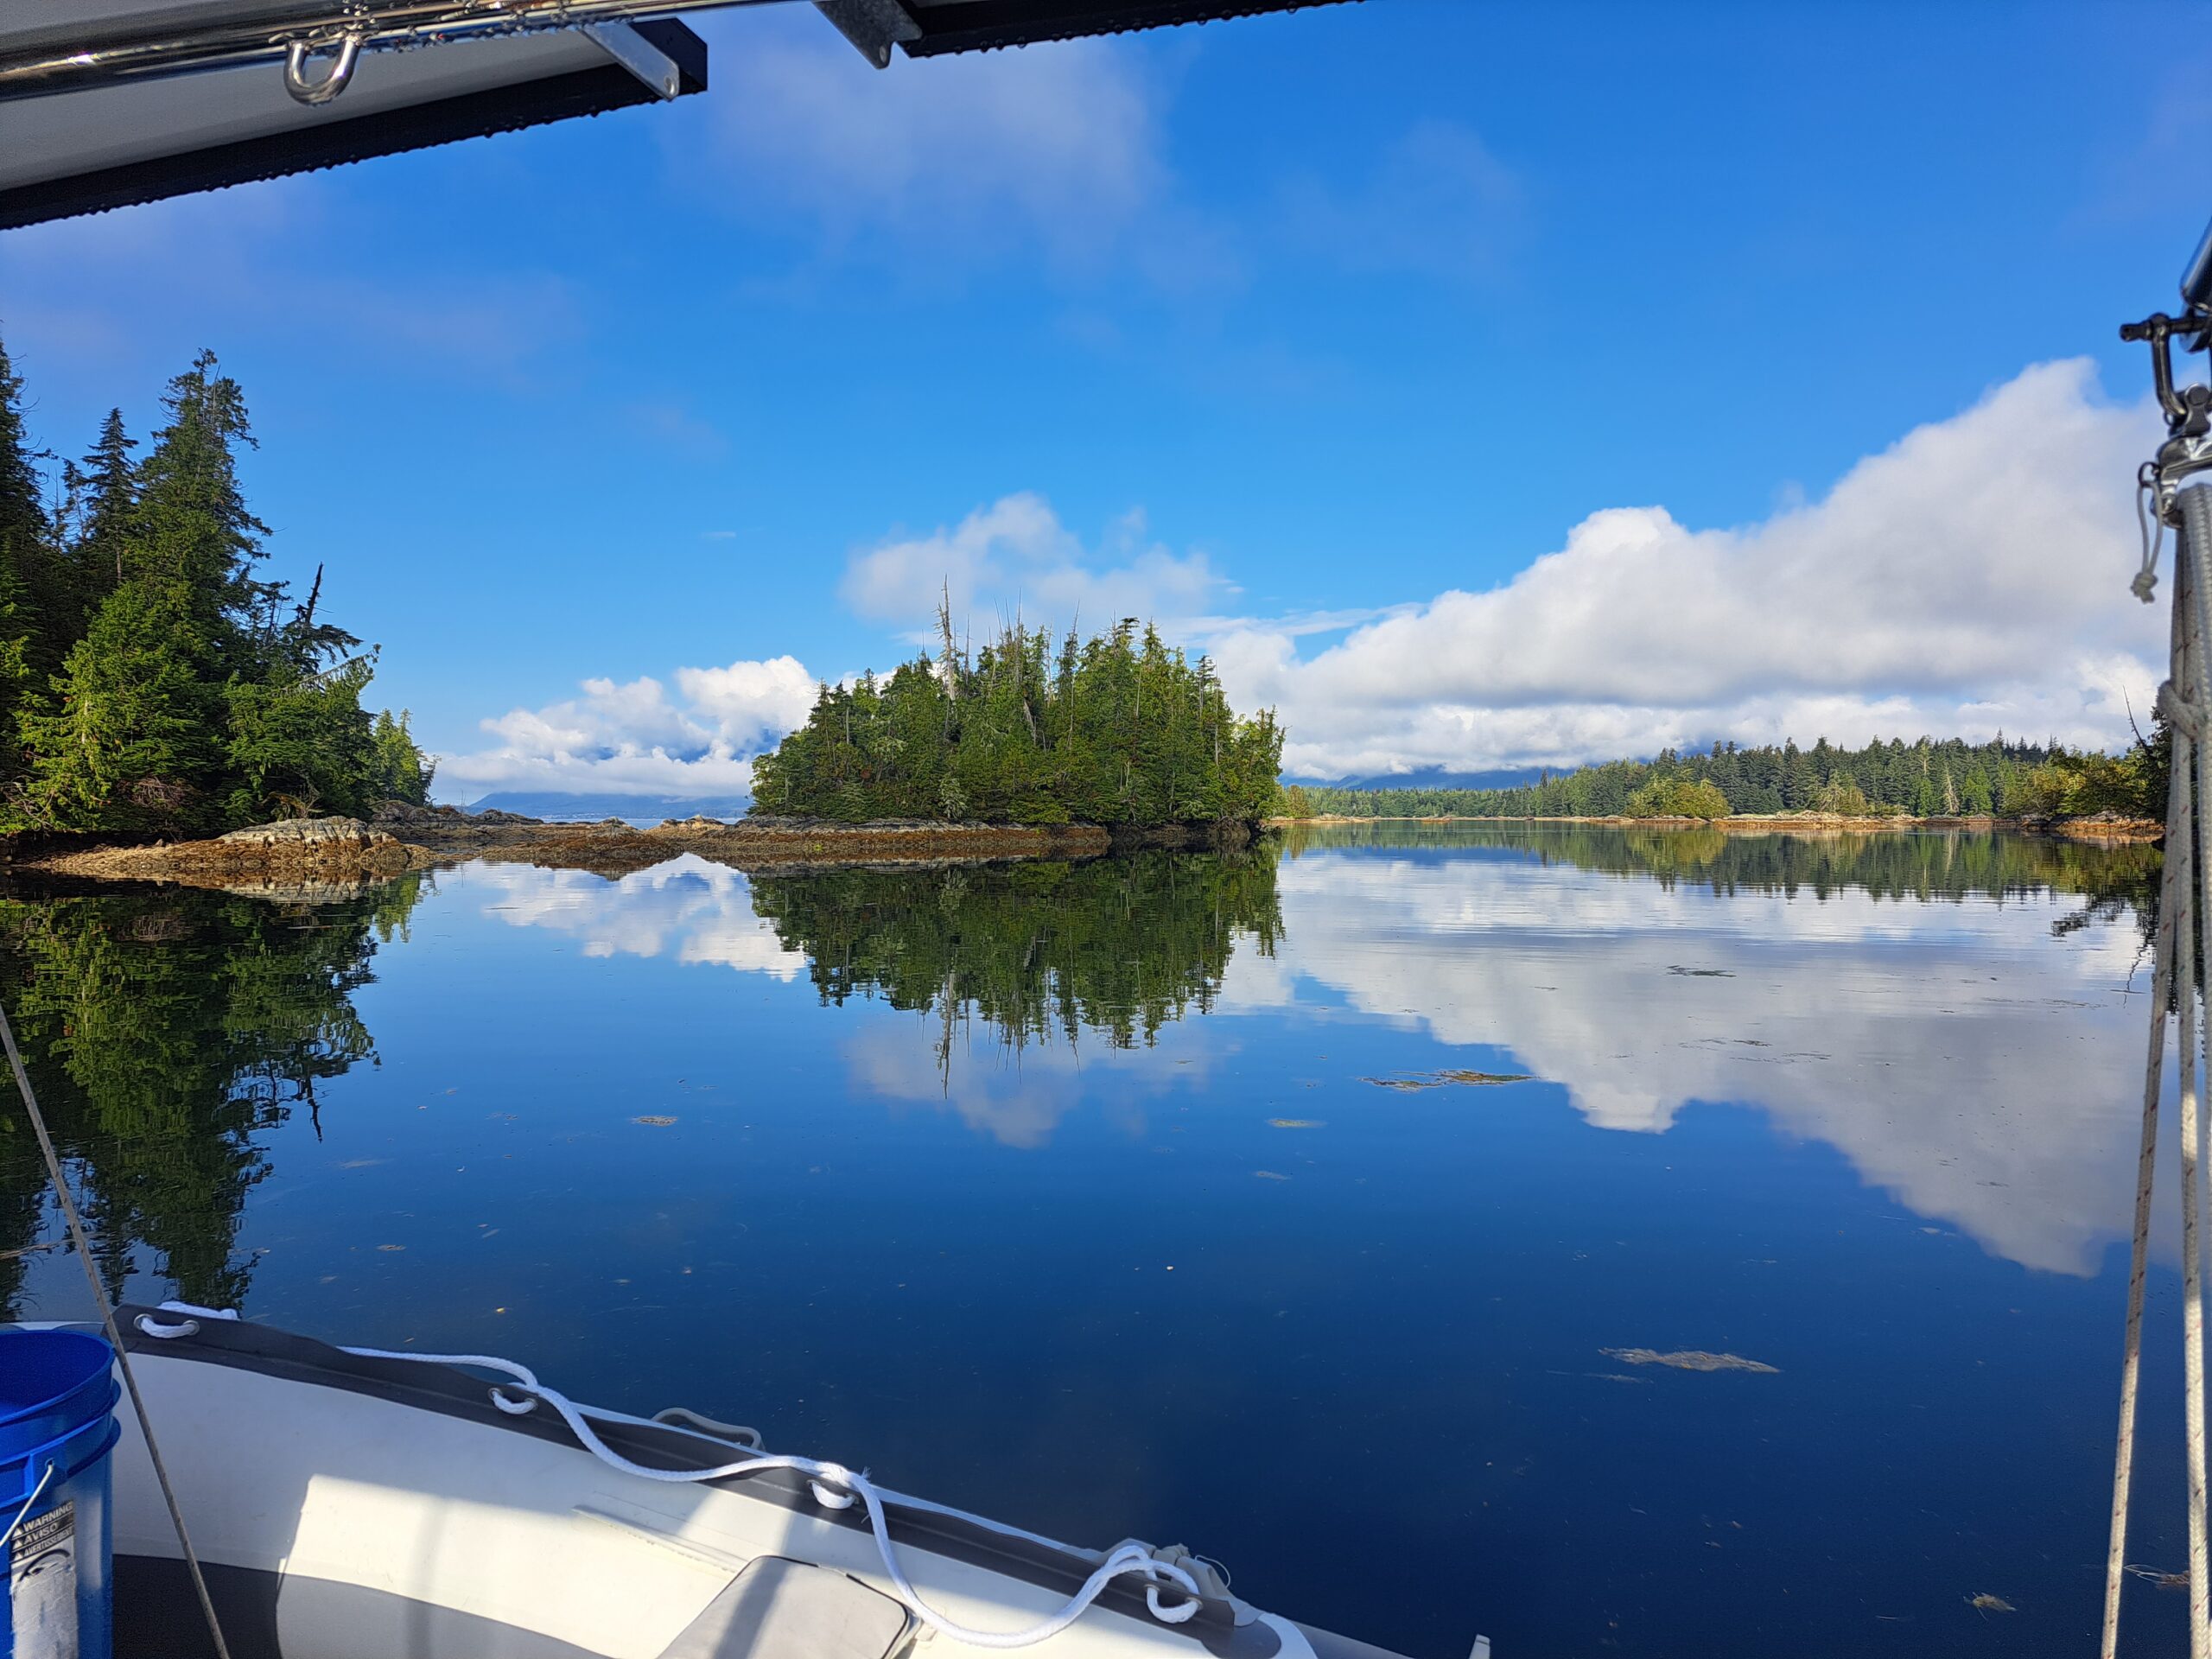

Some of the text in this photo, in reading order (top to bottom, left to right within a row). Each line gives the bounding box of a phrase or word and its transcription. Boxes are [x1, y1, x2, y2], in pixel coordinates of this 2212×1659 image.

[23, 1502, 73, 1532] WARNING
[24, 1522, 59, 1544] AVISO
[24, 1527, 73, 1556] AVERTISSEMENT
